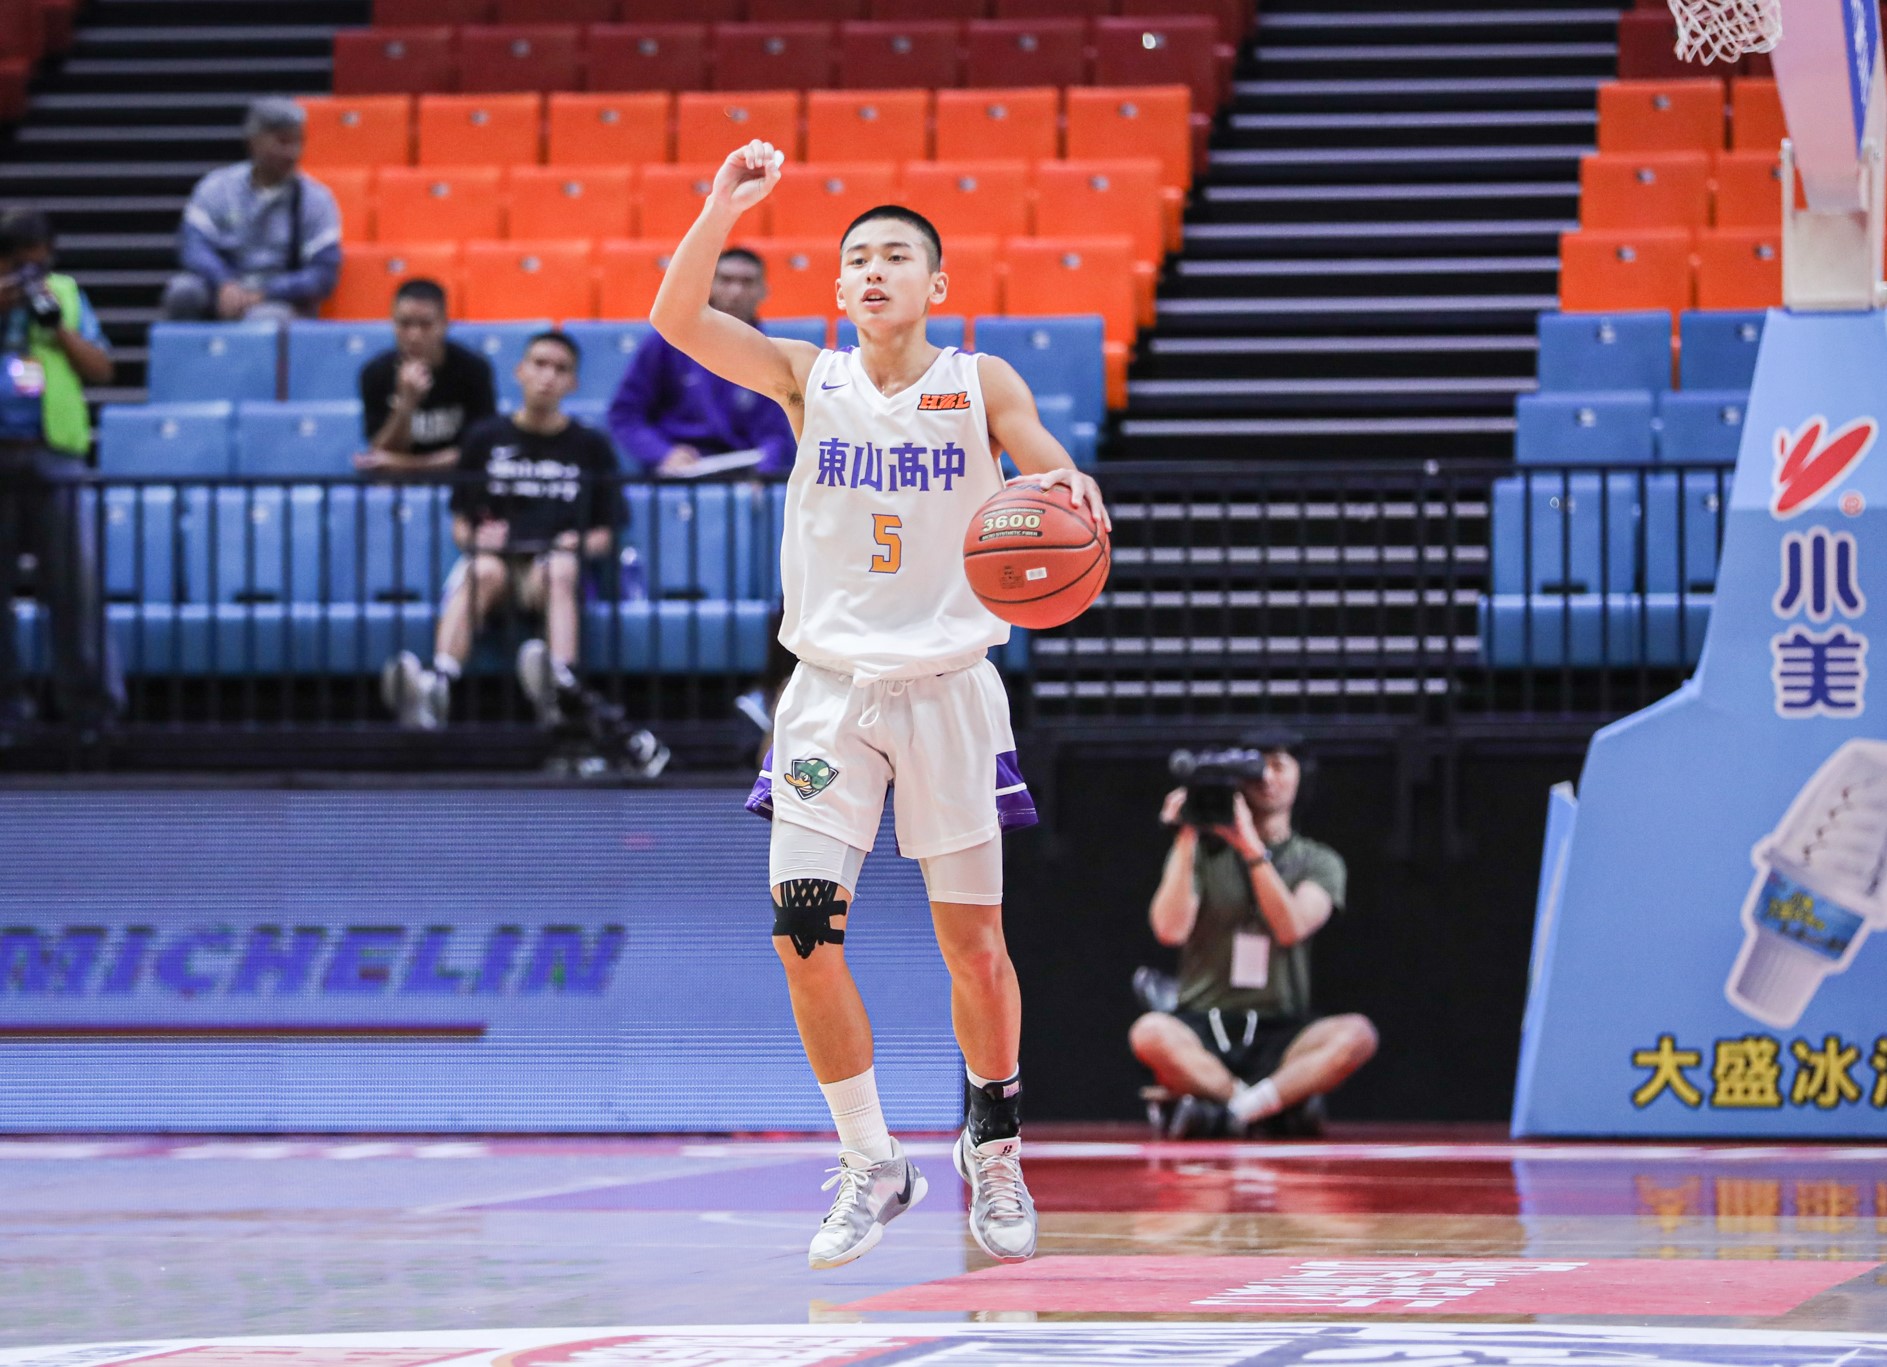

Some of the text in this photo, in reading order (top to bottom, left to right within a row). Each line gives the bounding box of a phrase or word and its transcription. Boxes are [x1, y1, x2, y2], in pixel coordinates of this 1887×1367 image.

[917, 391, 971, 410] HBL
[816, 437, 966, 492] 東山高中
[869, 513, 902, 574] 5
[982, 514, 1041, 532] 3600
[1776, 535, 1862, 709] 小美
[0, 925, 626, 995] MICHELIN
